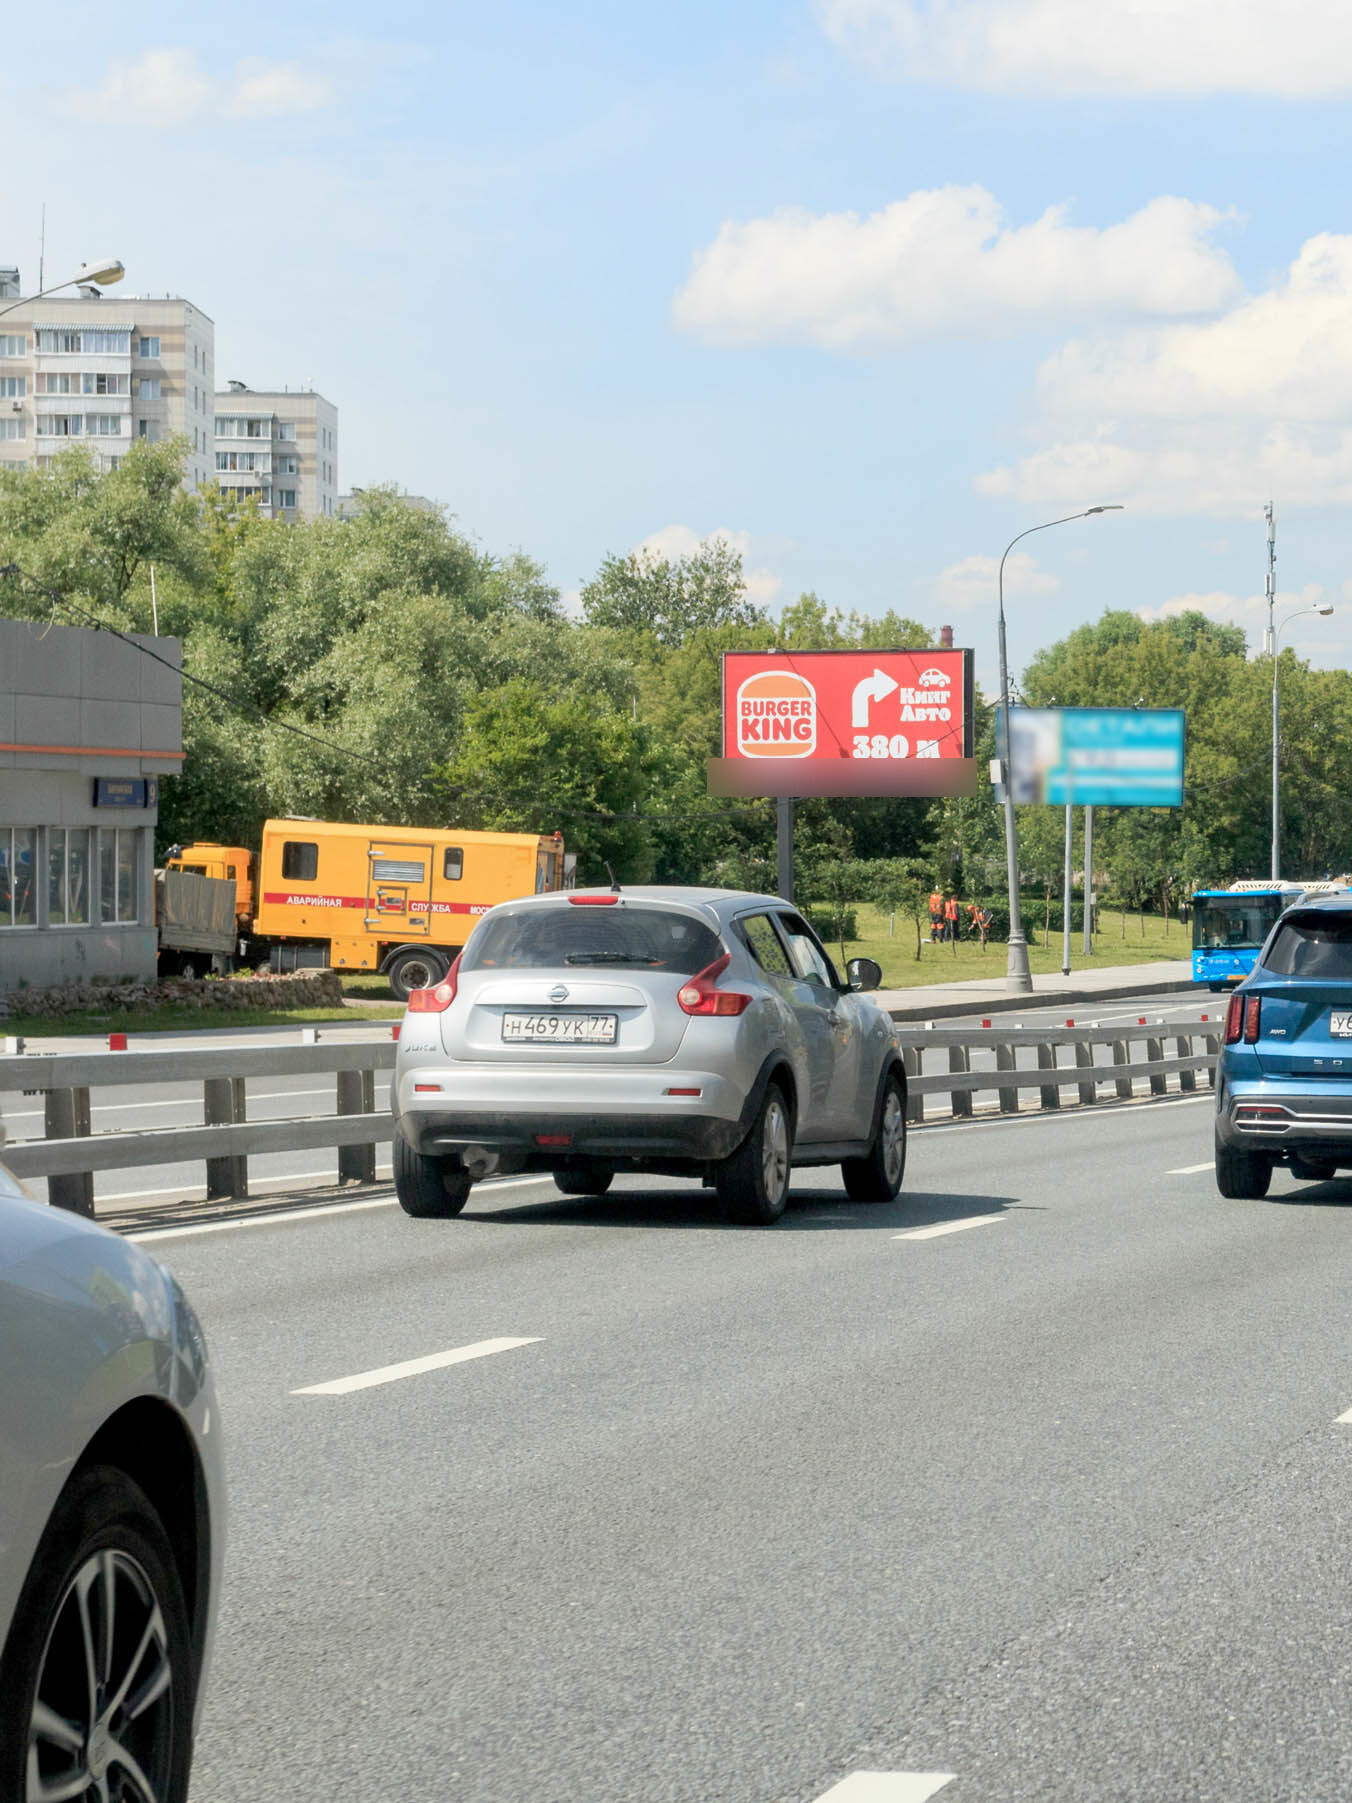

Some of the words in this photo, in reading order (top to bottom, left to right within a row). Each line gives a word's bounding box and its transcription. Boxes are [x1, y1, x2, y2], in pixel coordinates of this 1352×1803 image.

[741, 701, 812, 717] BURGER
[741, 718, 812, 741] KING
[853, 735, 909, 758] 380
[286, 895, 342, 907] АВАРИЙНАЯ
[411, 902, 451, 913] СЛУЖБА
[511, 1016, 584, 1035] Н469УК
[590, 1016, 609, 1030] 77
